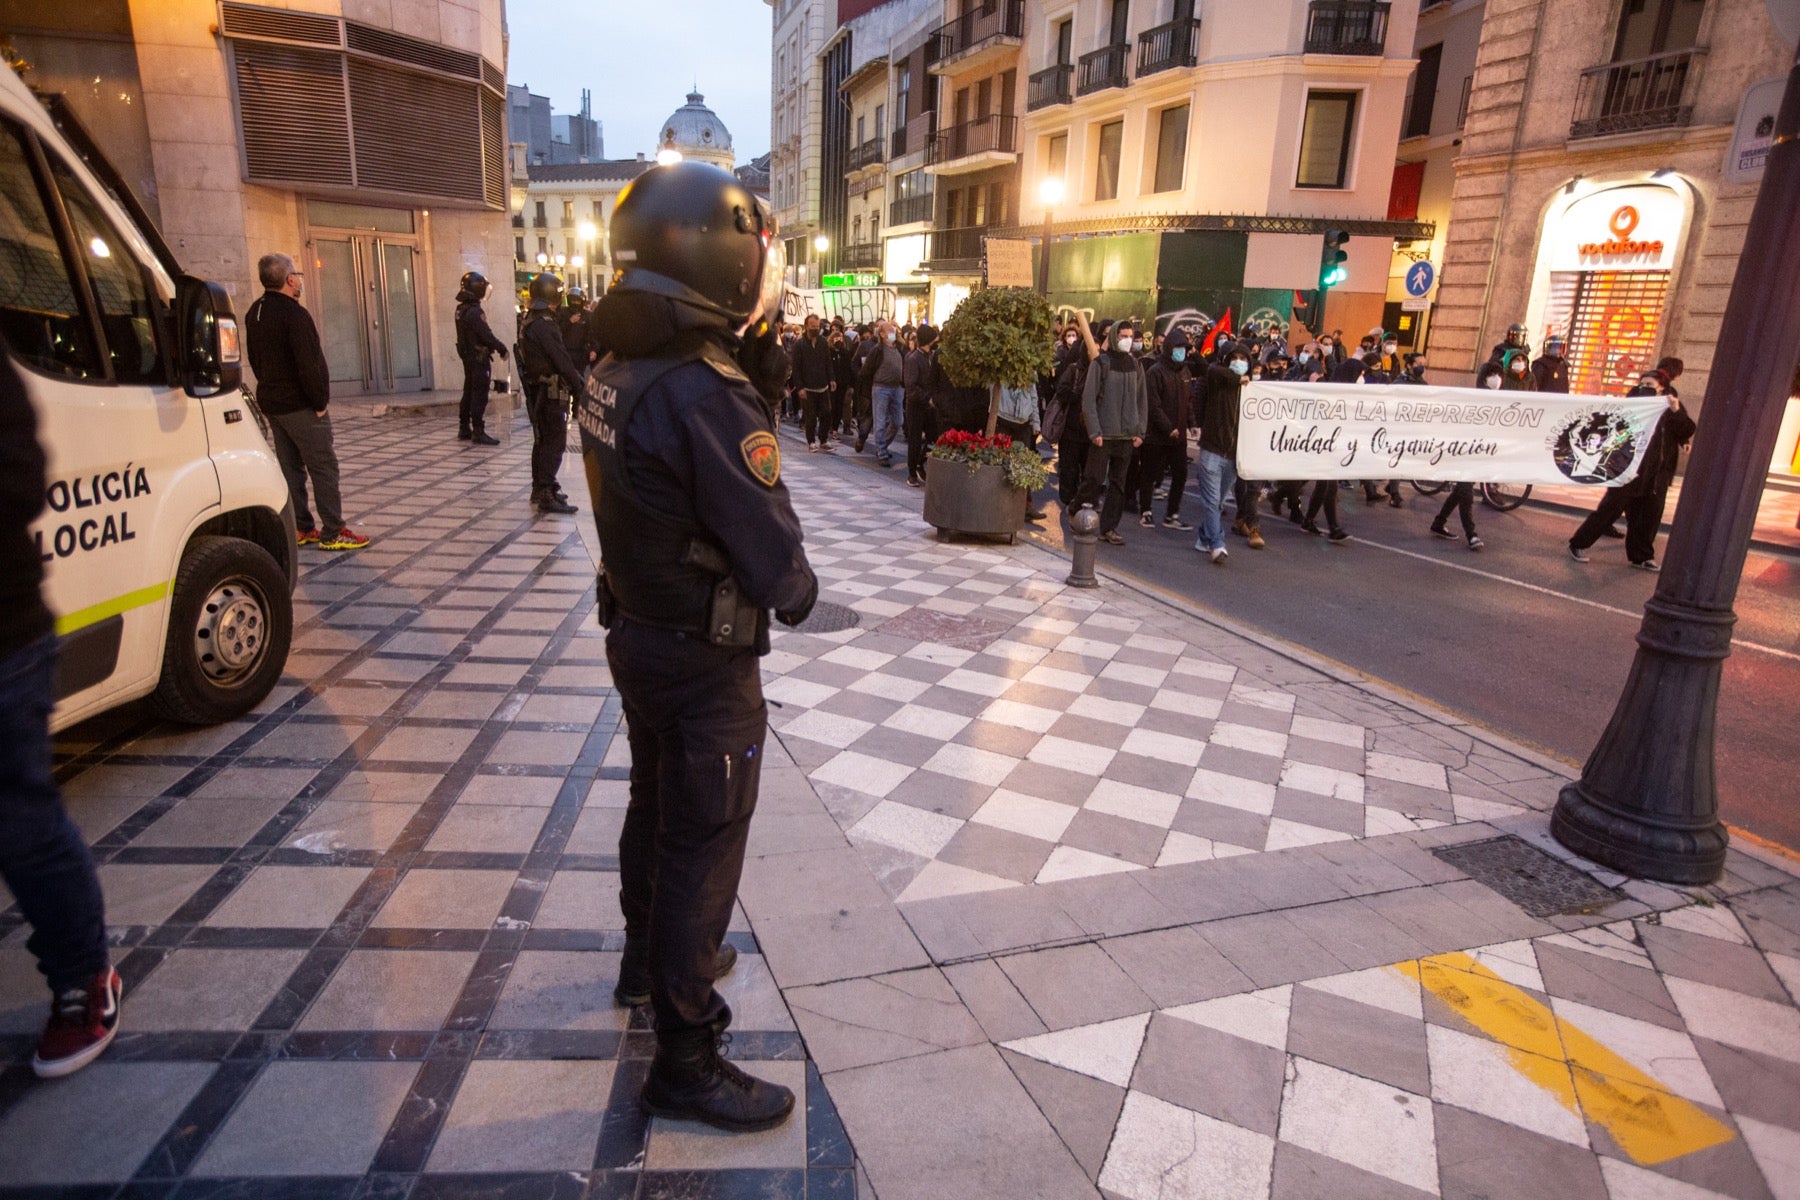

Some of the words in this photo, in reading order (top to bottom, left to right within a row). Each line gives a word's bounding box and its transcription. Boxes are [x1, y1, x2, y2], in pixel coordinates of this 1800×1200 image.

[1578, 237, 1664, 255] vodafone
[856, 275, 878, 286] 16H
[1242, 397, 1348, 421] CONTRA
[1354, 400, 1387, 422] LA
[1394, 401, 1545, 428] REPRESIÓN
[1269, 424, 1342, 454] Unidad
[1340, 437, 1359, 467] y
[1370, 426, 1498, 469] Organización
[46, 461, 152, 513] OLICÍA
[35, 511, 136, 563] LOCAL
